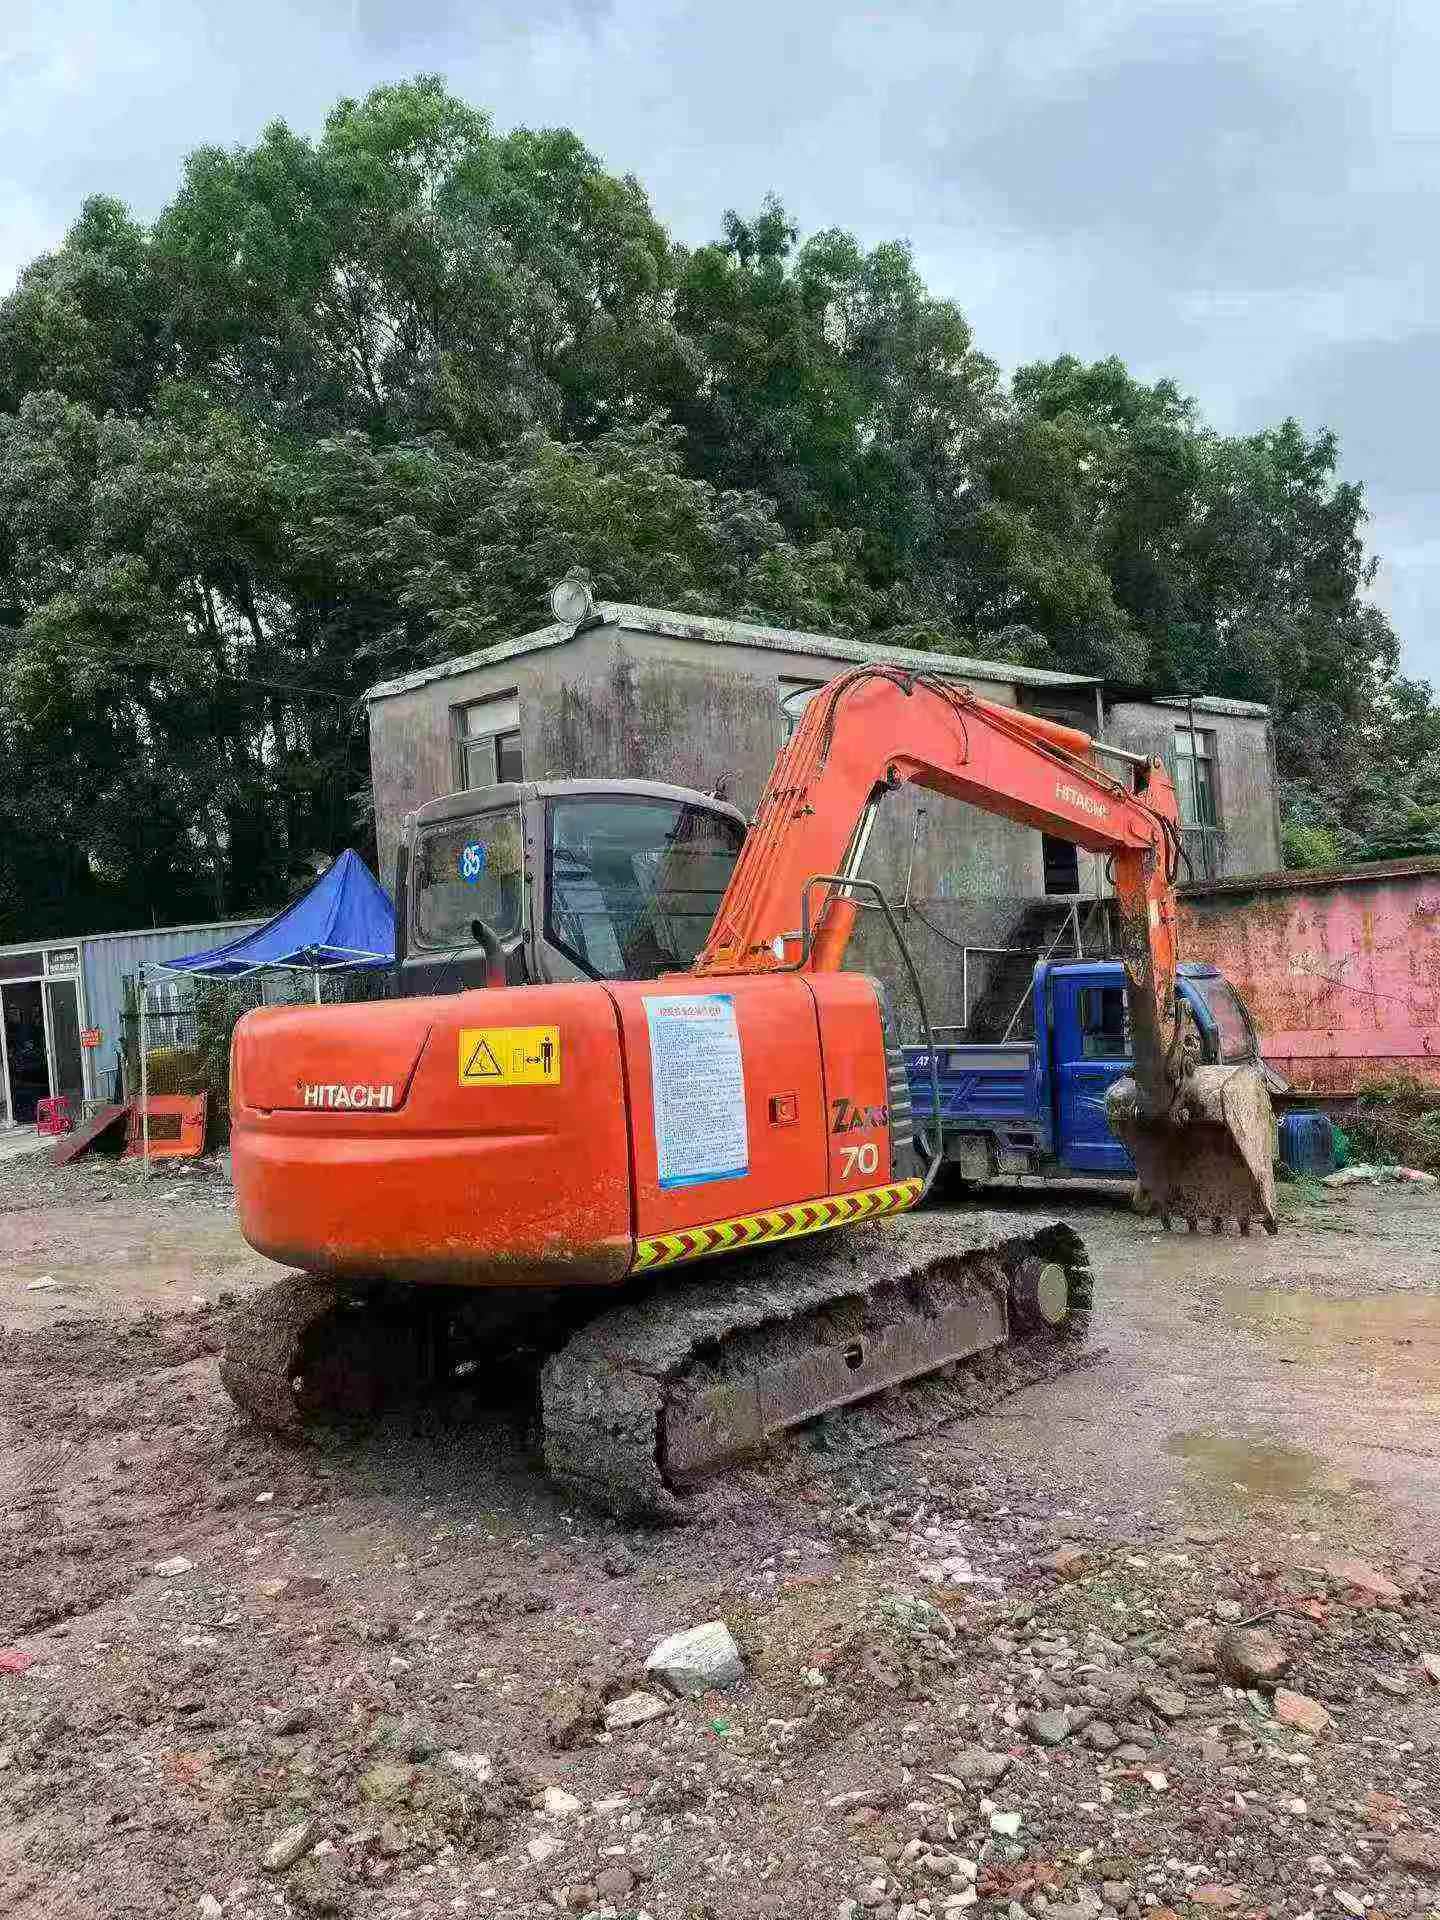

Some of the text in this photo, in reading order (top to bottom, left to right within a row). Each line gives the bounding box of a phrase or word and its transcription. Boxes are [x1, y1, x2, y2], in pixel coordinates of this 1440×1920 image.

[463, 846, 480, 876] 85
[303, 1084, 394, 1108] HITACHI
[839, 1143, 879, 1180] 70
